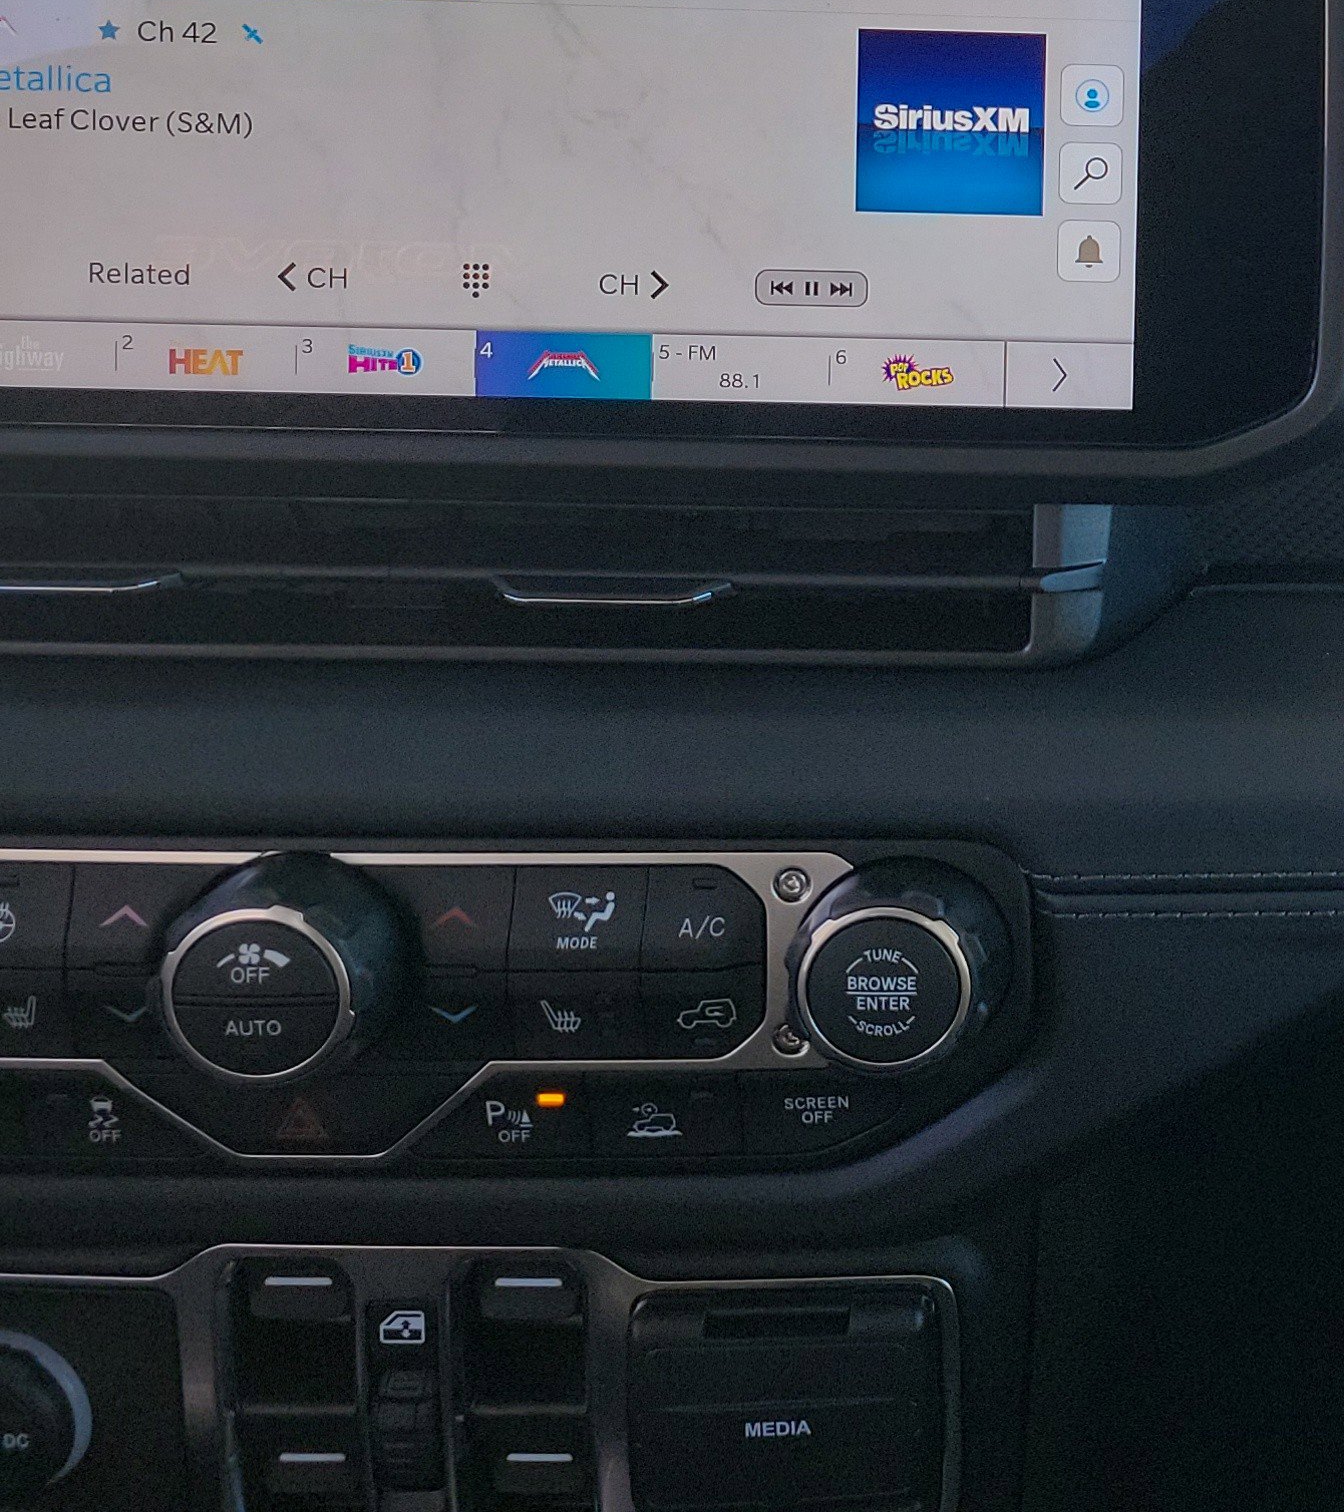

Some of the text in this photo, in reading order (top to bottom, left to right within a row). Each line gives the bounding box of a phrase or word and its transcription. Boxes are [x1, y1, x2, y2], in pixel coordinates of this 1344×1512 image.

[136, 20, 218, 44] Ch 42
[8, 107, 254, 140] Leaf Clover (S&M)
[873, 103, 1030, 135] SiriusXM
[87, 262, 192, 287] Related
[306, 266, 349, 289] CH
[598, 274, 640, 296] CH
[122, 334, 134, 350] 2
[301, 339, 314, 355] 3
[480, 342, 494, 359] 4
[658, 344, 670, 360] 5
[688, 345, 717, 360] FM
[835, 350, 847, 365] 6
[168, 348, 244, 376] HEAT
[719, 373, 761, 389] 88.1
[895, 368, 954, 390] ROCKS
[678, 916, 726, 939] A/C
[555, 935, 598, 950] MODE
[863, 949, 902, 964] TUNE
[230, 966, 270, 985] OFF
[846, 975, 917, 991] BROWSE
[856, 995, 911, 1012] ENTER
[224, 1019, 282, 1038] AUTO
[856, 1019, 911, 1038] SCROLL
[783, 1095, 850, 1111] SCREEN
[800, 1110, 834, 1124] OFF
[88, 1129, 122, 1144] OFF
[497, 1130, 531, 1143] OFF
[743, 1419, 812, 1440] MEDIA
